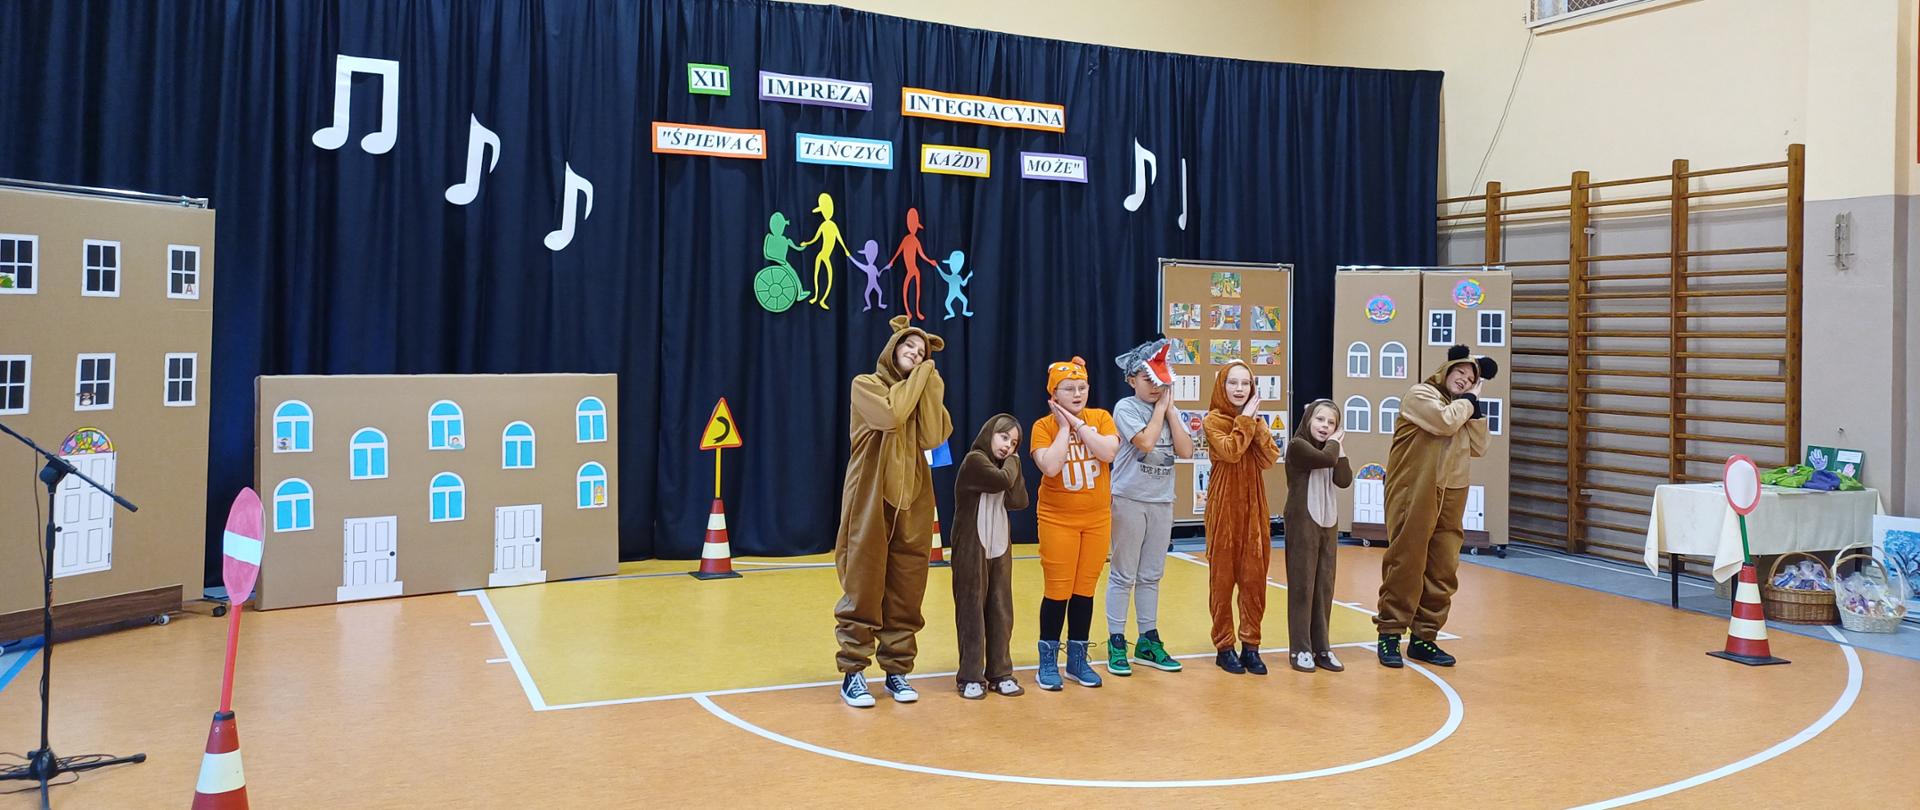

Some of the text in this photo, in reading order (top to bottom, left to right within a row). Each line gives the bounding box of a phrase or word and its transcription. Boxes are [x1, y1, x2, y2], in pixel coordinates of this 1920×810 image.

[693, 70, 1062, 126] XII IMPREZA INTEGRACYJNA
[662, 128, 1080, 175] "ŚPIEWAĆ, TAŃCZYĆ KAŻDY MOŻE"
[1062, 460, 1101, 491] UP
